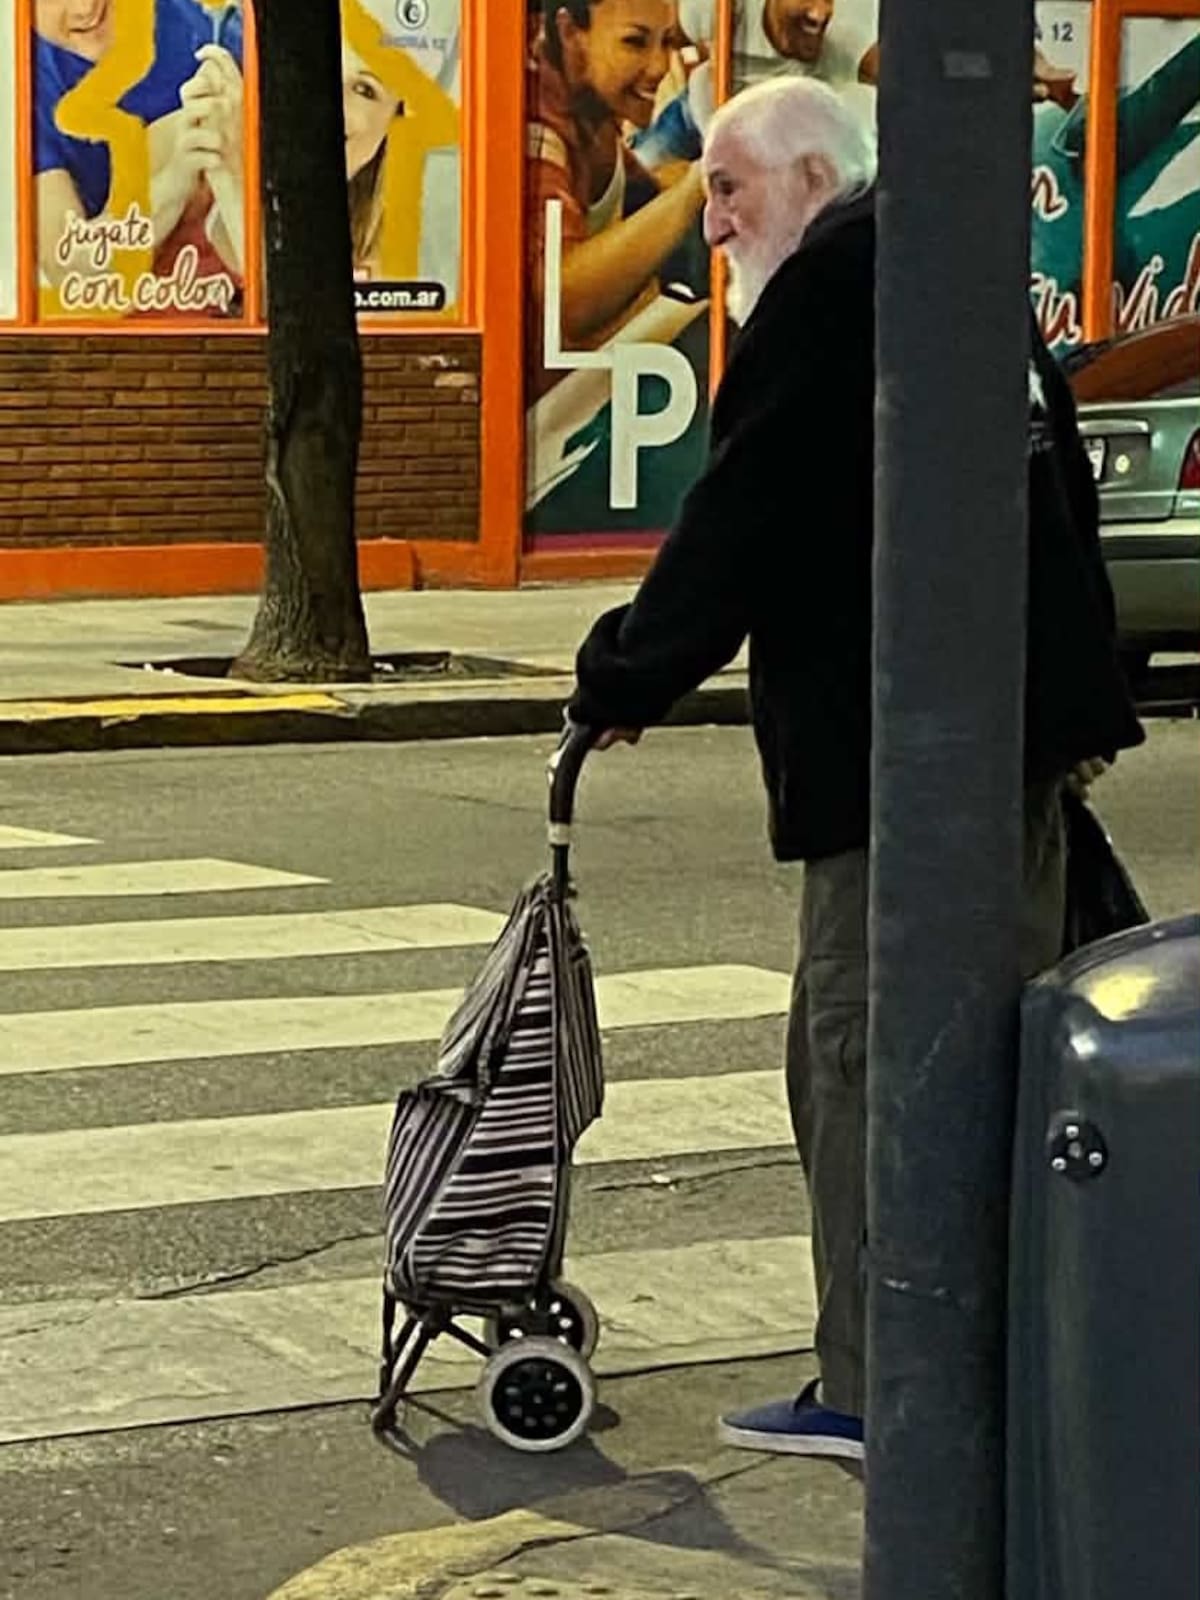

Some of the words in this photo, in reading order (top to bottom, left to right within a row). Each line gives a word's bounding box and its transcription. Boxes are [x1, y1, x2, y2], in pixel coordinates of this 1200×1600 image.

[1052, 24, 1073, 41] 12
[57, 202, 153, 267] jugate
[59, 271, 130, 310] con
